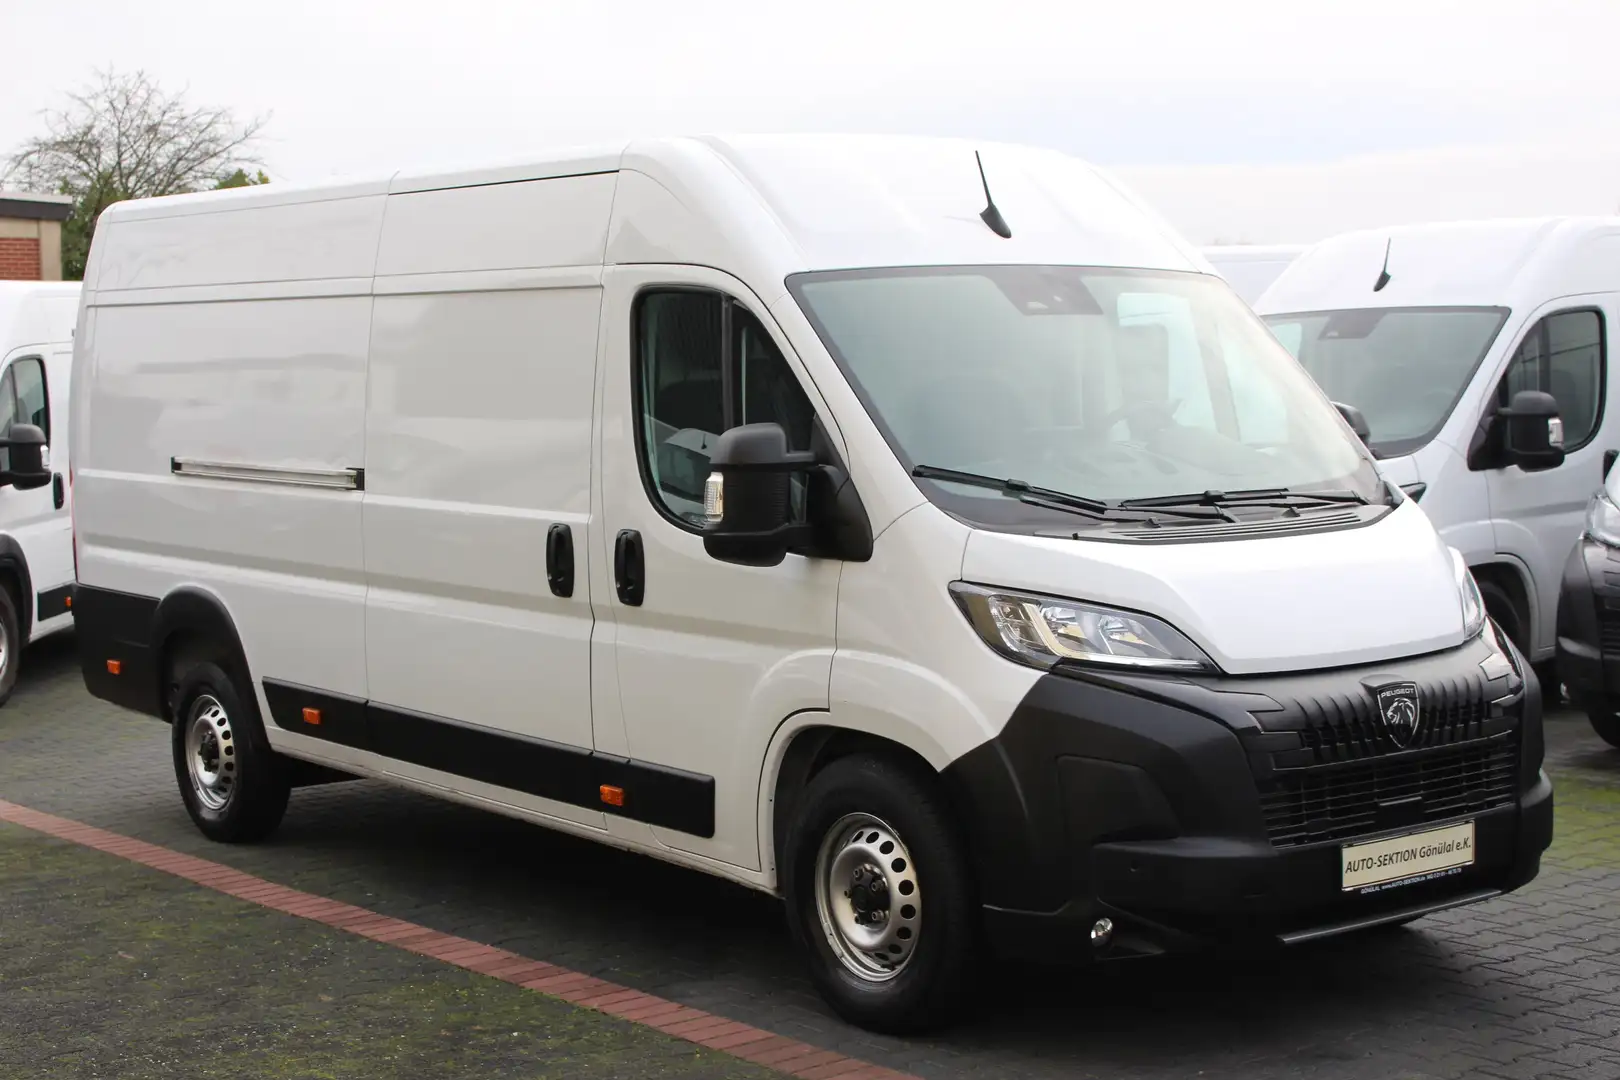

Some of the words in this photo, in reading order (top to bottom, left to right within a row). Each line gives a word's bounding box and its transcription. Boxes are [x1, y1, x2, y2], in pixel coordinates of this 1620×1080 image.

[1381, 688, 1414, 698] PEUGEOT
[1345, 848, 1417, 873] AUTO-SEKTION
[1419, 840, 1455, 858] Gönülal
[1456, 837, 1472, 850] e.K.
